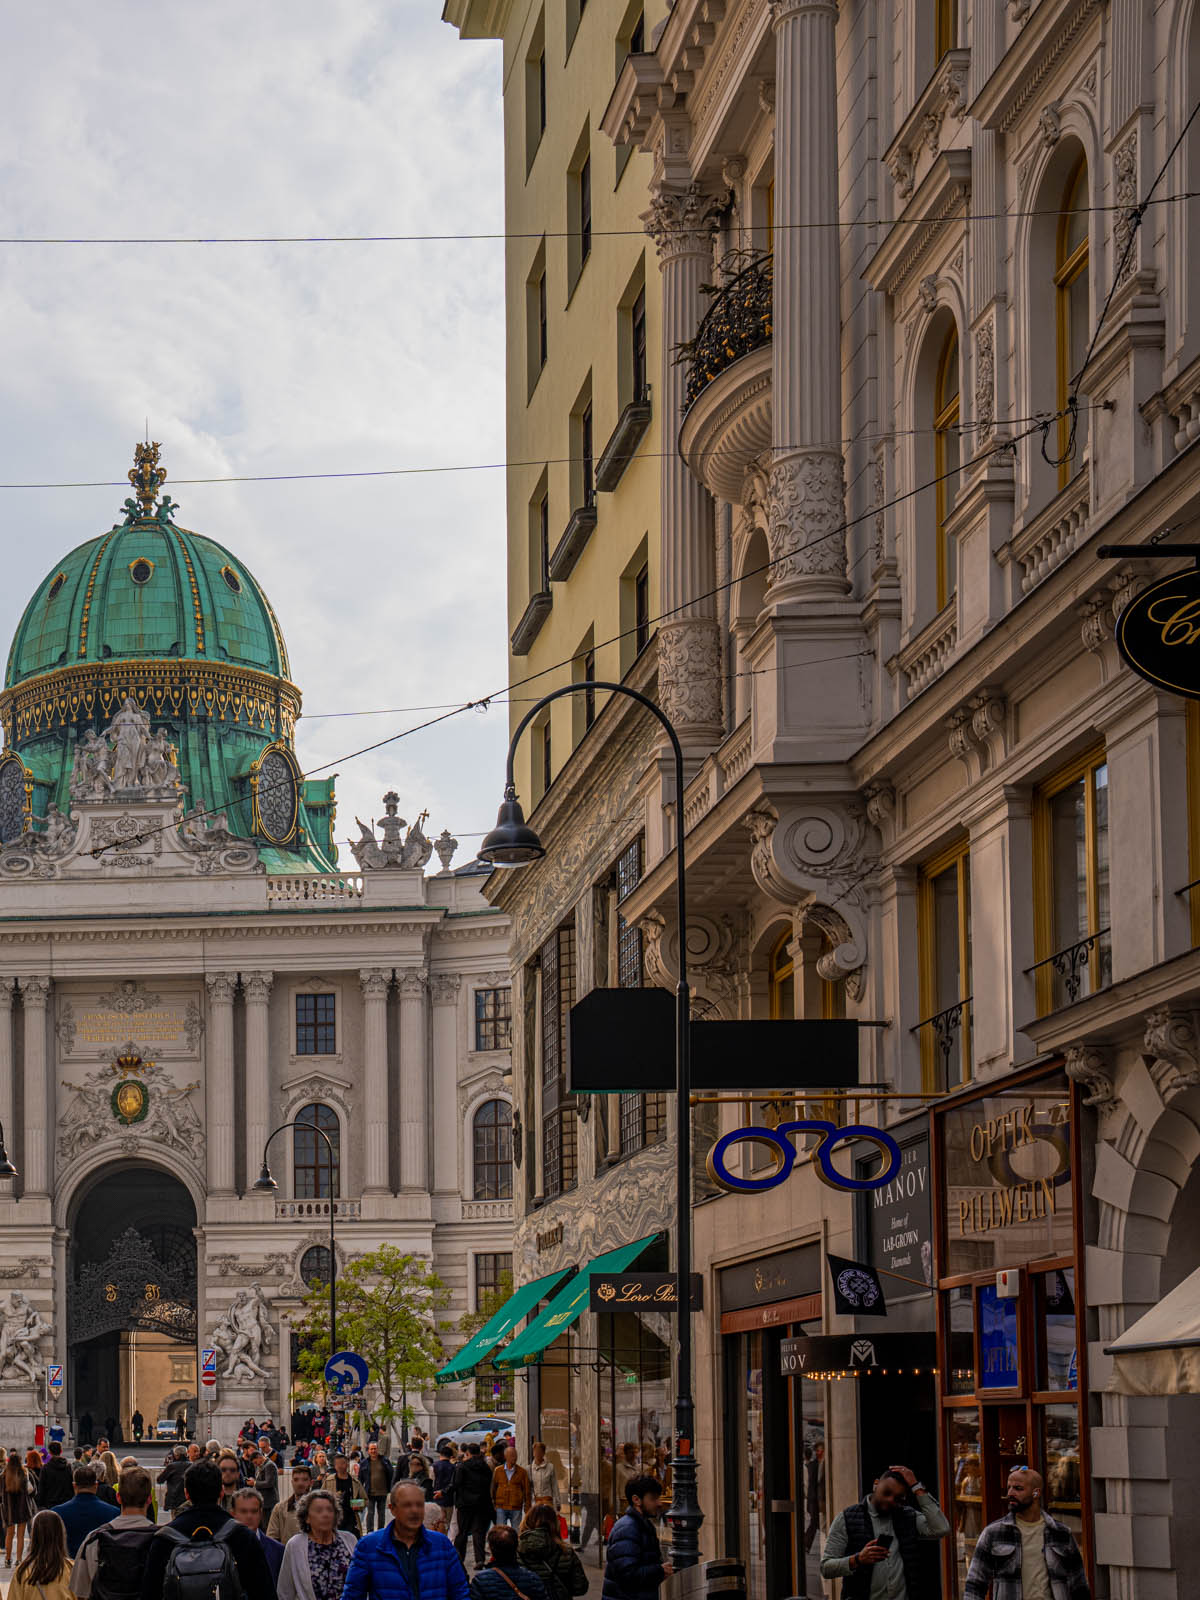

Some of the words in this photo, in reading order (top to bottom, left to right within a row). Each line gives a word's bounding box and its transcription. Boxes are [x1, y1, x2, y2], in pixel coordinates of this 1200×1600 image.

[970, 1104, 1037, 1162] OPTIK
[873, 1166, 927, 1209] MANOV
[960, 1176, 1056, 1236] PILLWEIN
[890, 1216, 904, 1230] Home
[883, 1229, 919, 1252] LAB-GROWN
[616, 1282, 651, 1302] Loro
[654, 1281, 693, 1303] Pia
